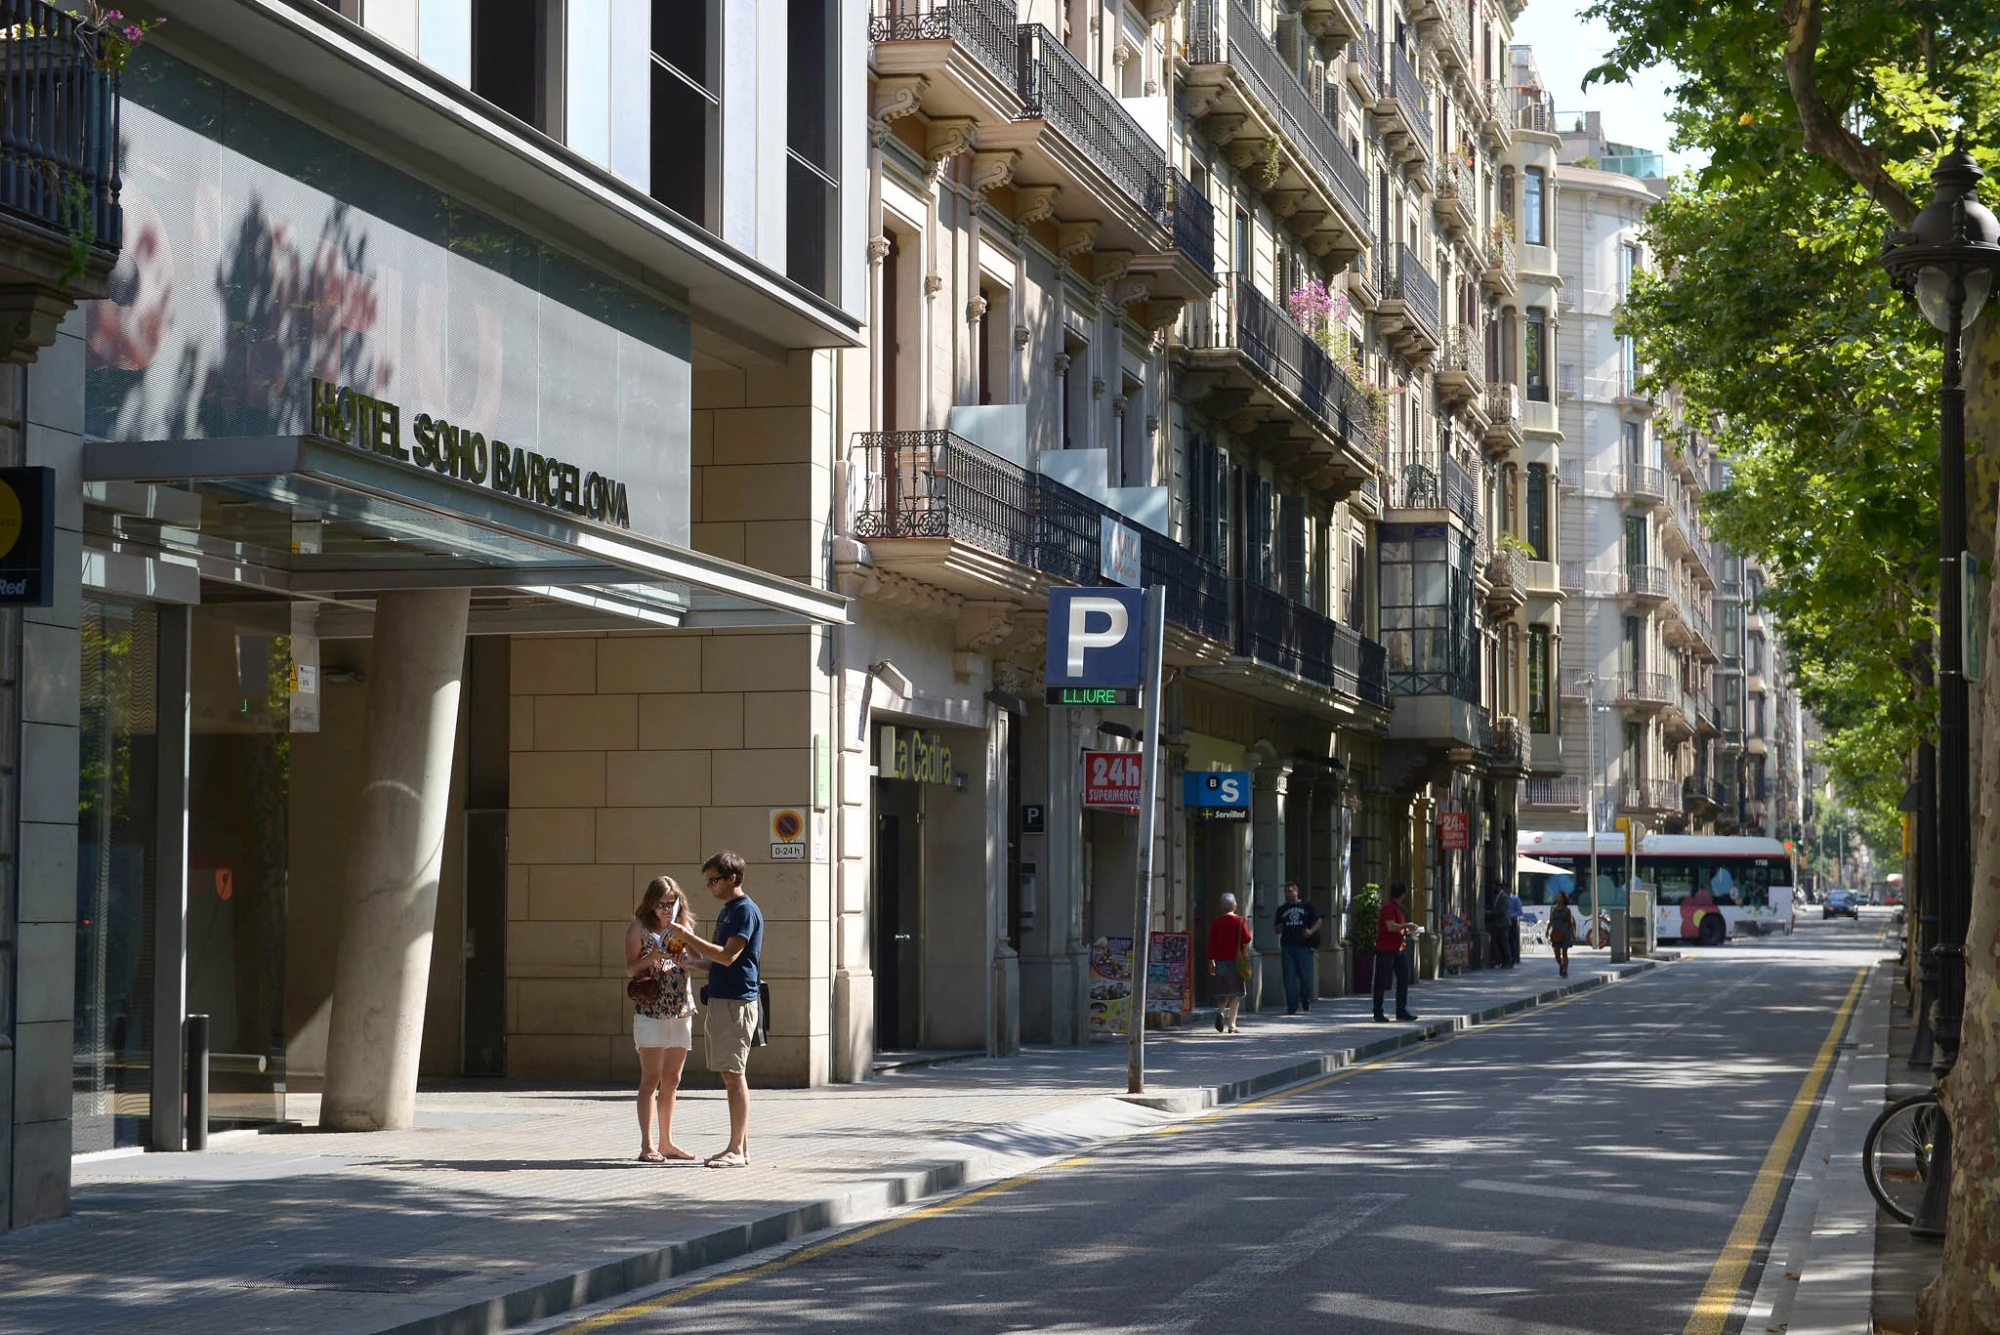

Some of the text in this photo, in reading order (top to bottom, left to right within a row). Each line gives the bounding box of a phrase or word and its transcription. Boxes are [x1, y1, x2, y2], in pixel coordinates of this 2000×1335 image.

[311, 377, 630, 529] HOTEL SOHO BARCELONA
[1067, 596, 1128, 677] P
[1063, 689, 1116, 704] LLIURE
[889, 727, 908, 779] La
[912, 729, 952, 784] Cadira
[1092, 757, 1140, 787] 24h
[1210, 779, 1240, 803] B S
[1027, 807, 1039, 824] P
[1214, 810, 1246, 819] ServiRed
